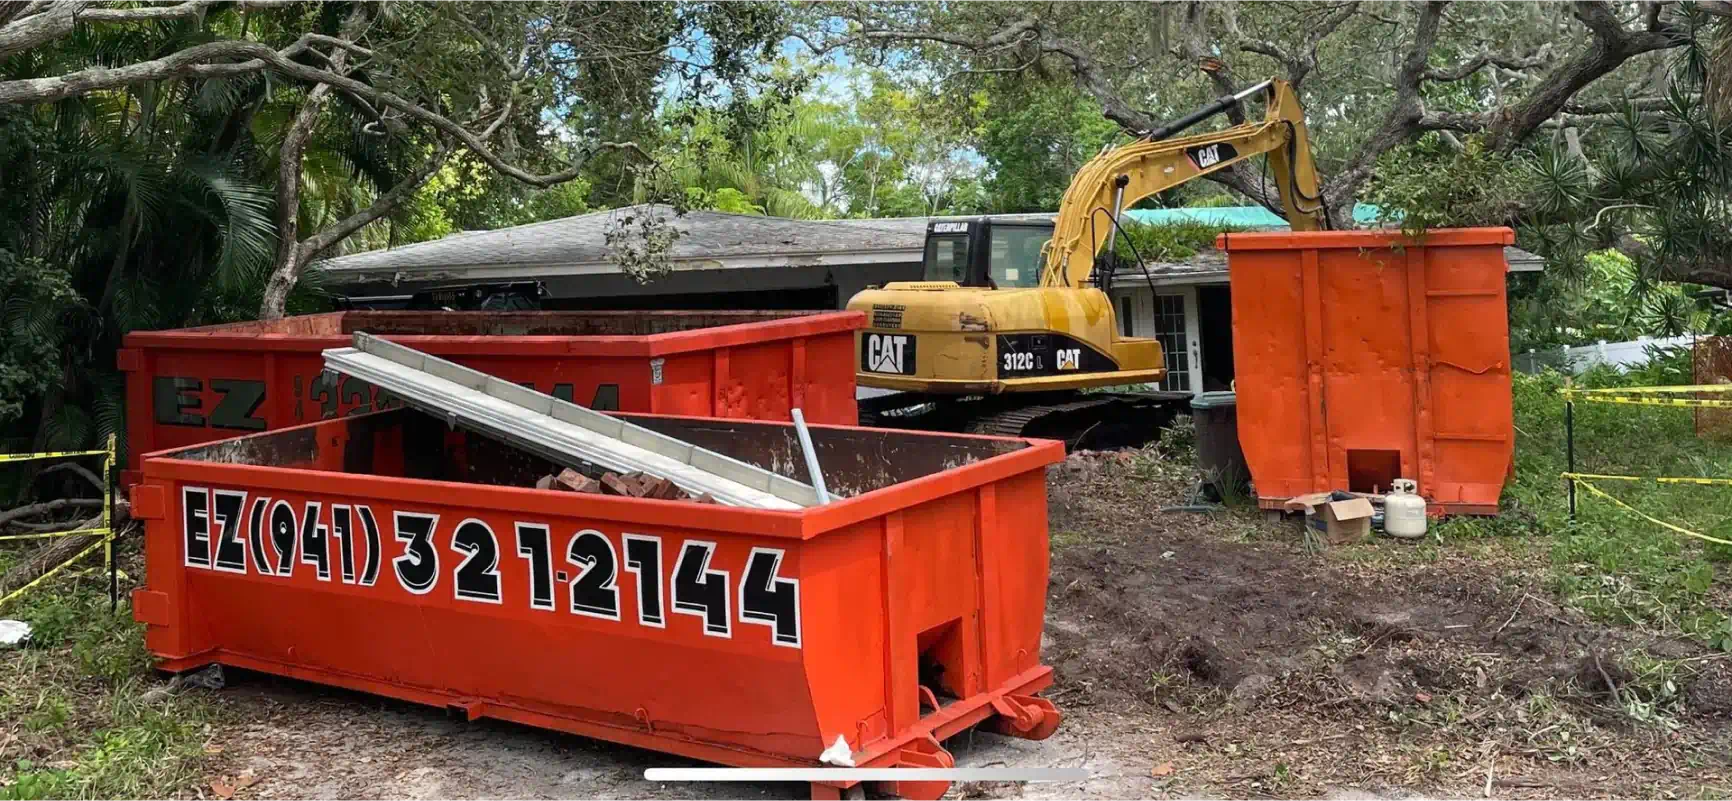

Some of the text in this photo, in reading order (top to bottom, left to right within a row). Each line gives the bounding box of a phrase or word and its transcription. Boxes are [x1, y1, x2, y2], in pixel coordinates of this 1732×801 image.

[1198, 143, 1220, 168] CAT
[934, 222, 969, 233] CATERPILLAR
[868, 334, 908, 374] CAT
[1003, 352, 1034, 371] 312C
[1056, 348, 1081, 371] CAT
[152, 376, 267, 431] EZ
